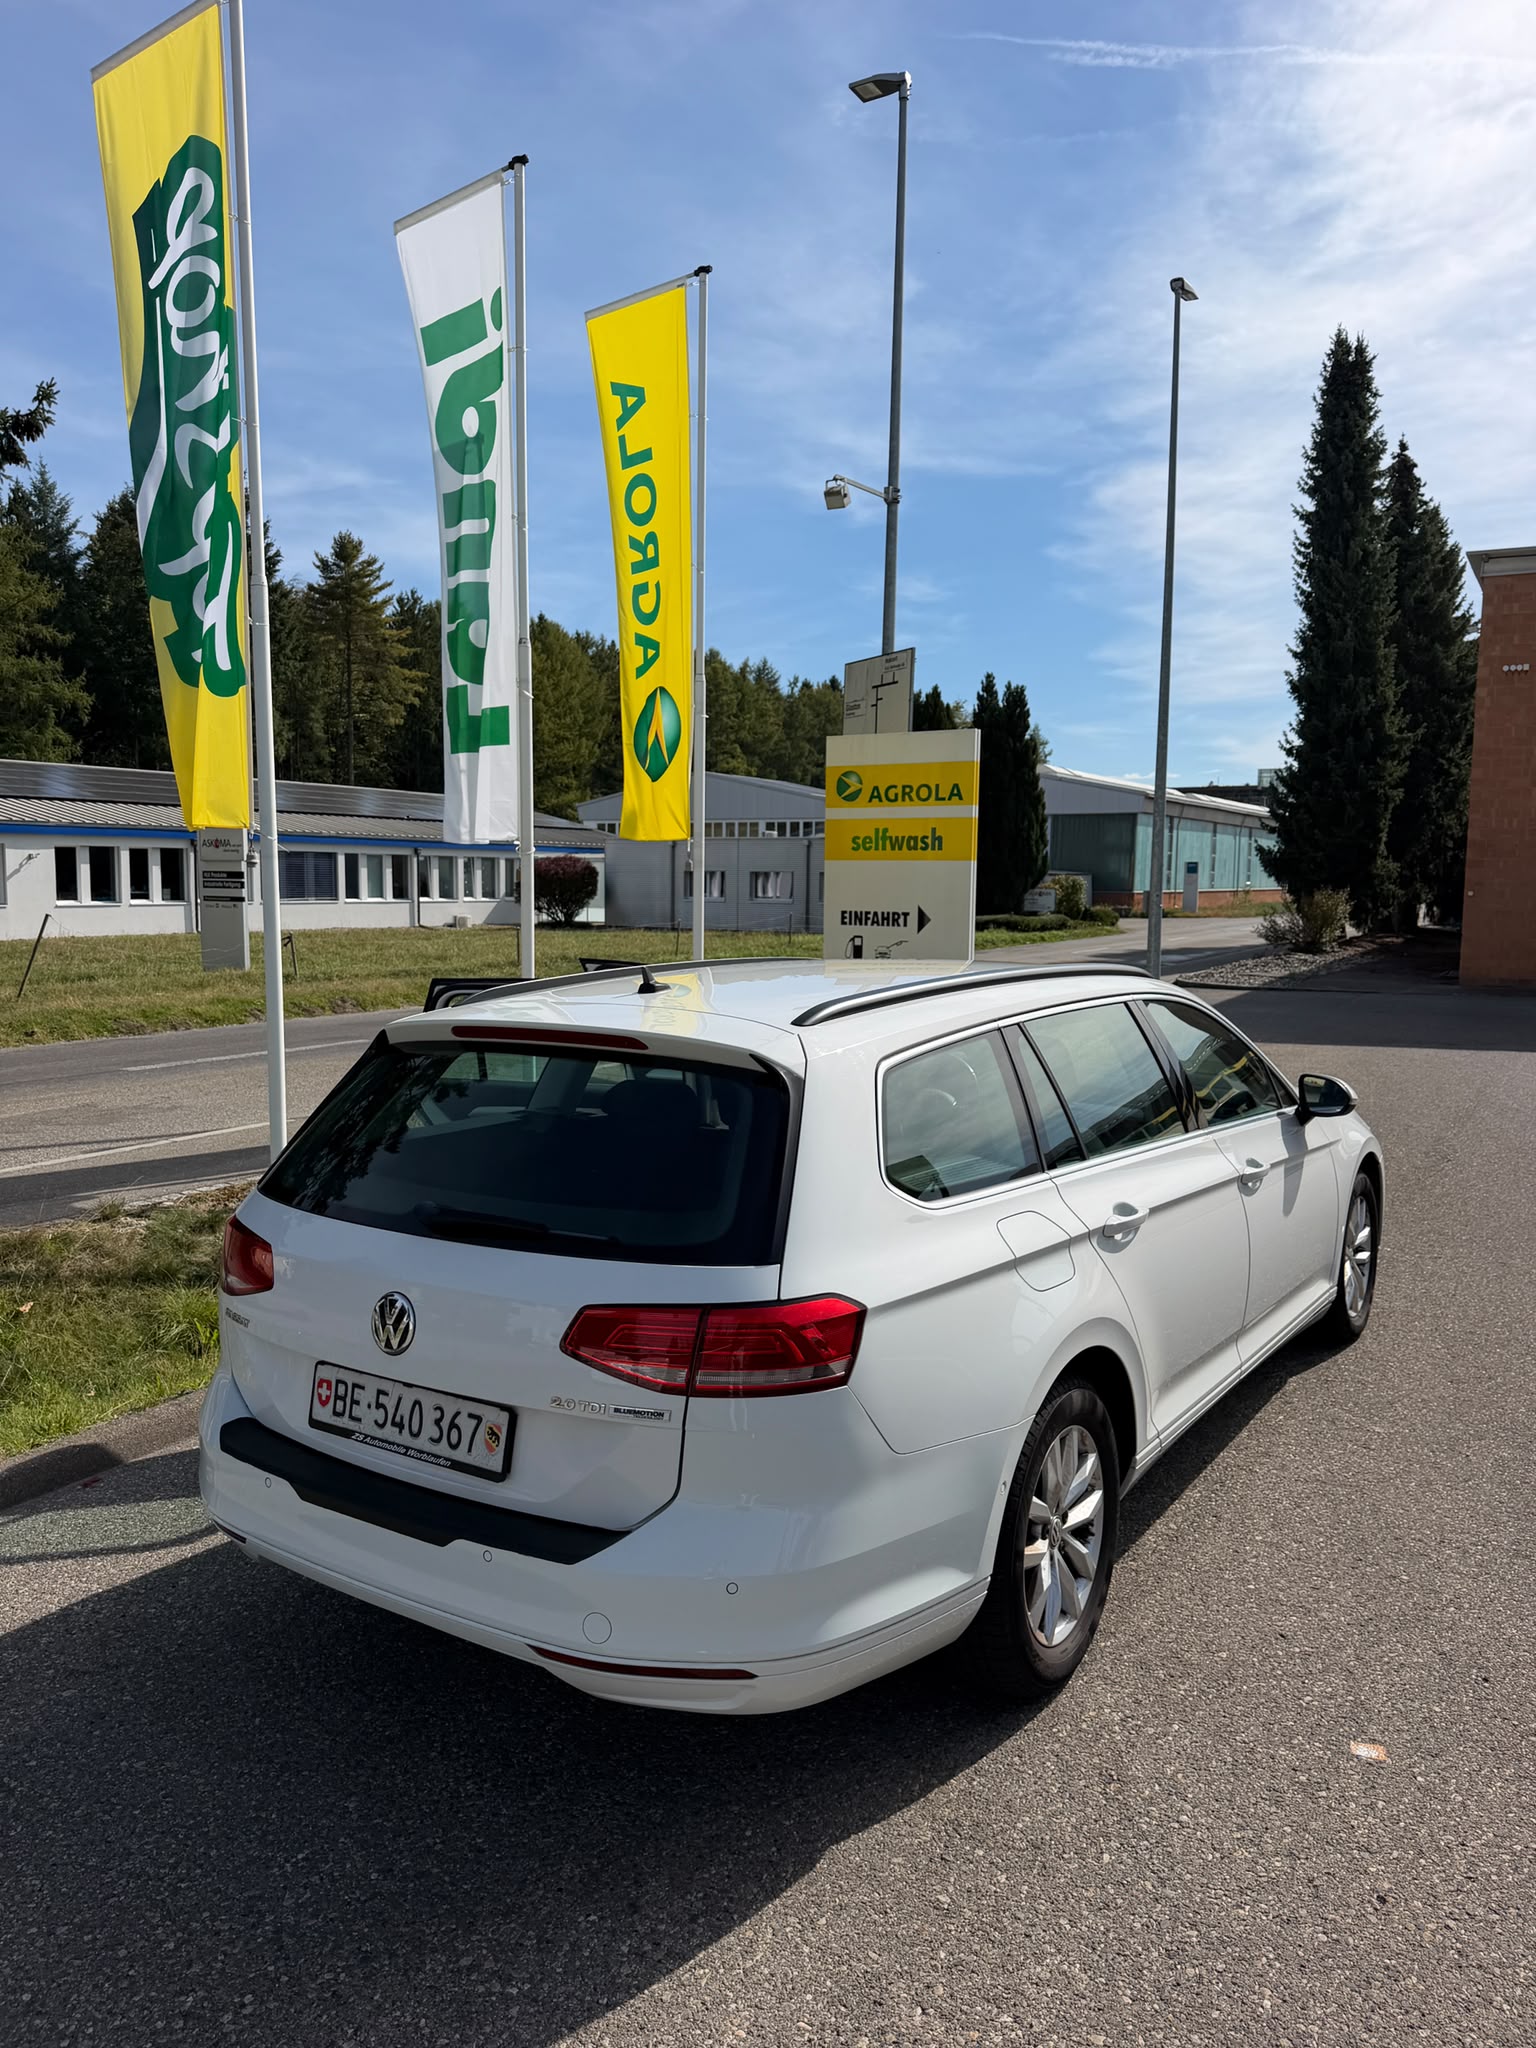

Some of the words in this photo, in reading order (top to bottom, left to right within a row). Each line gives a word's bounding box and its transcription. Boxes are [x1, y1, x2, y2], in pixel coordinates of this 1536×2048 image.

[868, 783, 963, 803] AGROLA
[851, 827, 943, 851] selfwash
[840, 910, 910, 928] EINFAHRT
[613, 1407, 665, 1418] BLUEMOTION
[428, 1404, 483, 1455] 367
[351, 1432, 365, 1441] ZS
[363, 1436, 406, 1454] Automobile
[406, 1448, 452, 1467] Worblaufen
